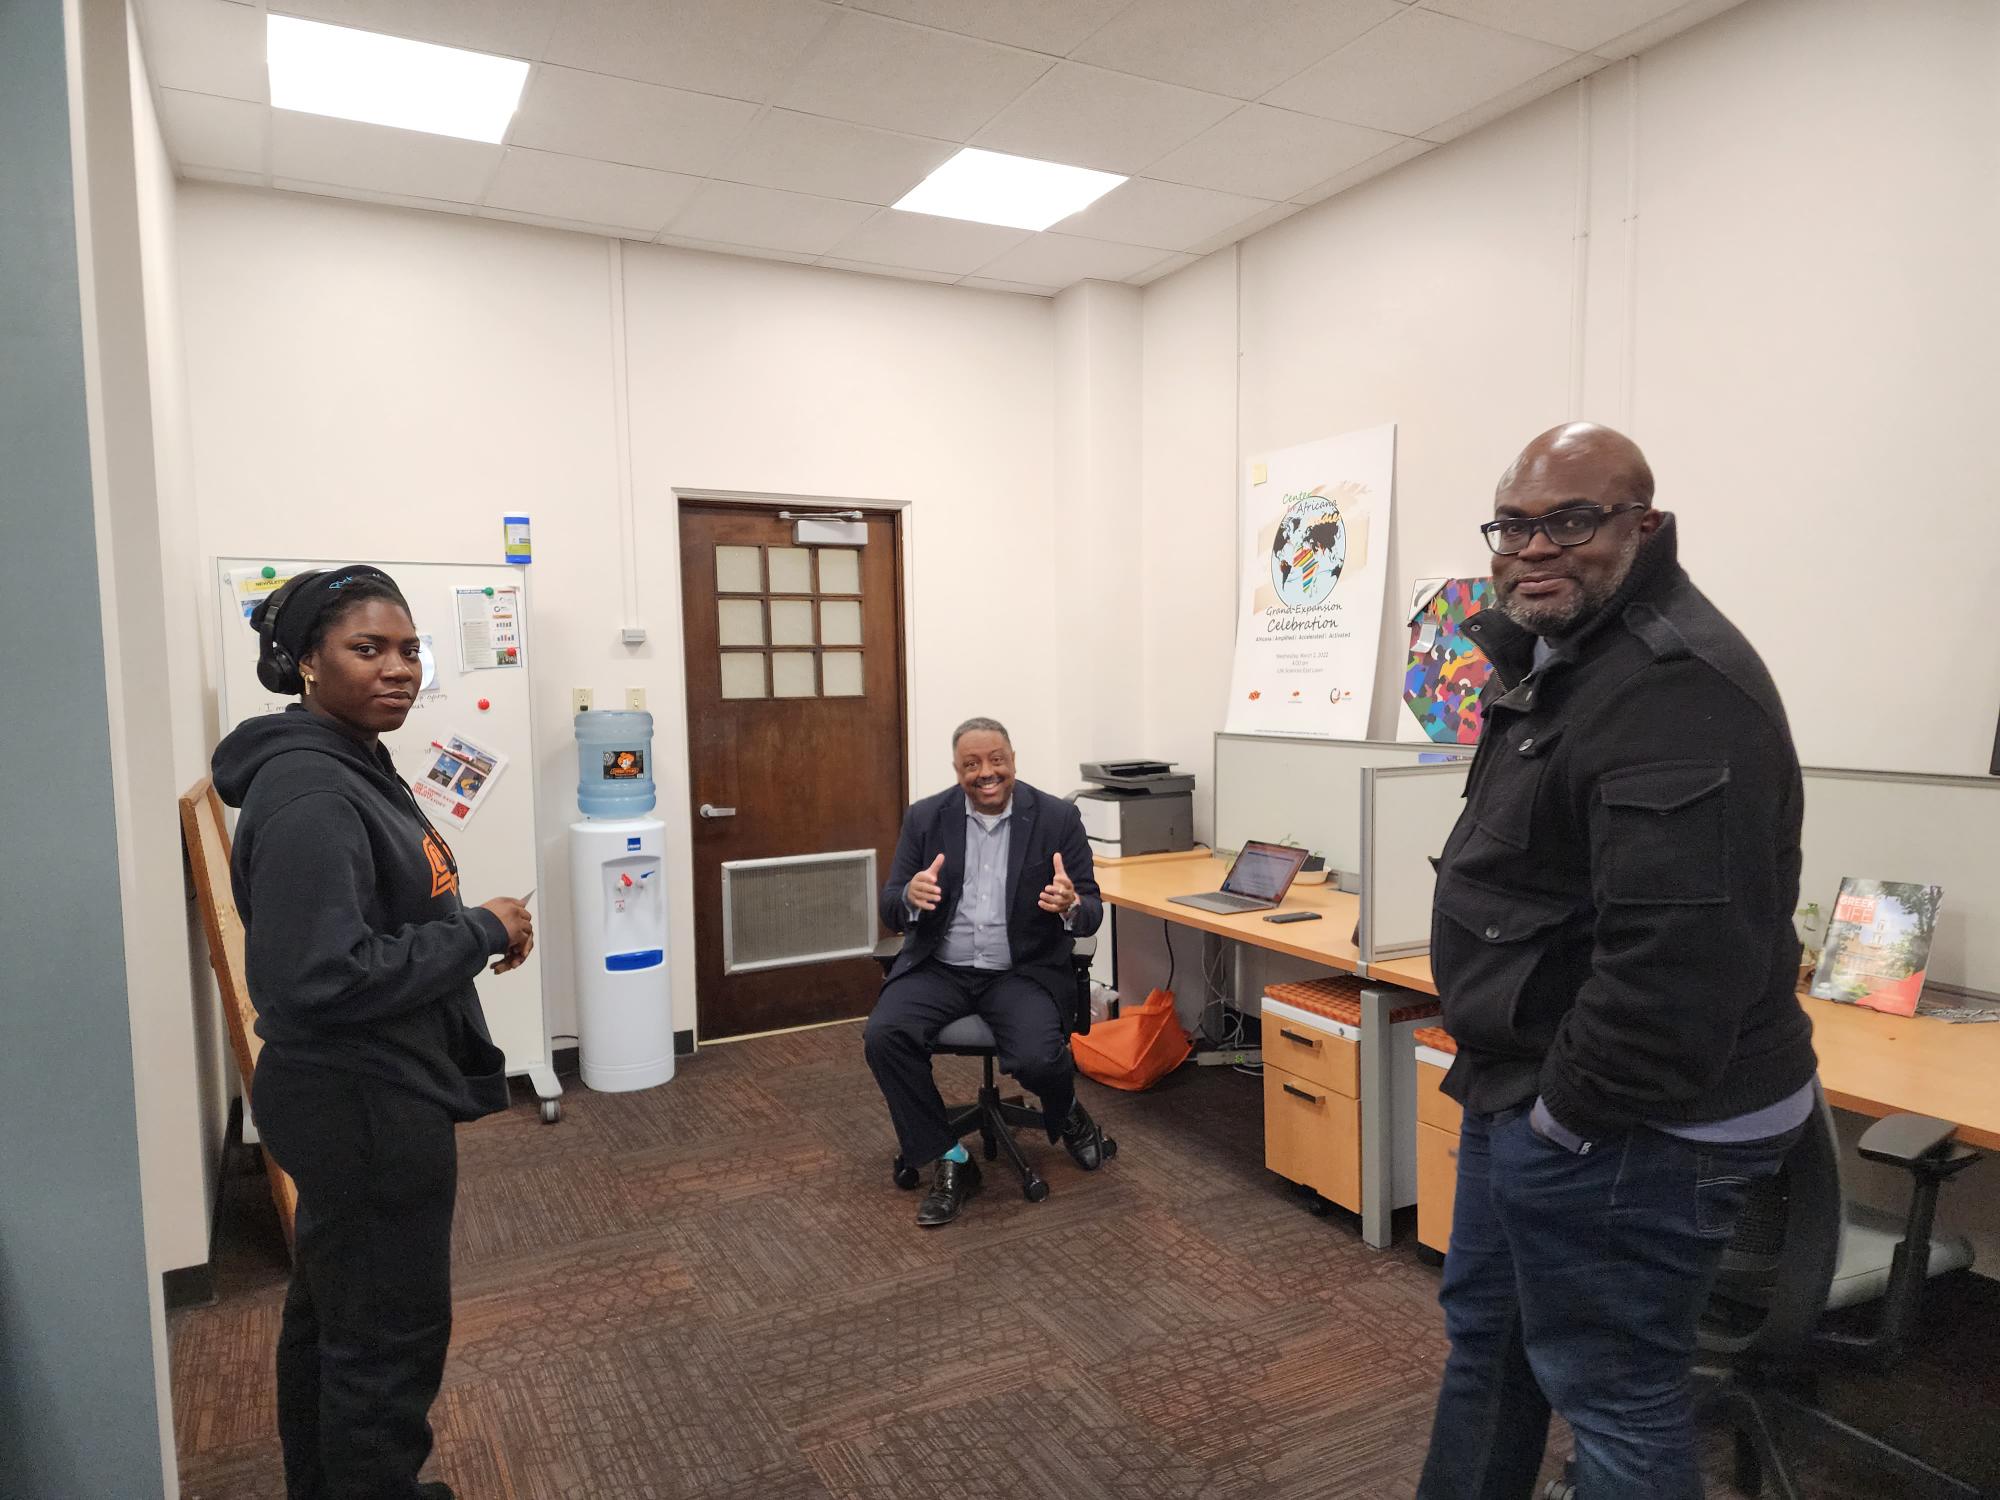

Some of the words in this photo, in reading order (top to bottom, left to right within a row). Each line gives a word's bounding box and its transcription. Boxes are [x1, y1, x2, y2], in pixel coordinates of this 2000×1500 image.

[1283, 491, 1312, 504] Center
[1297, 500, 1338, 515] Africana
[256, 579, 289, 587] NEWSLETTE
[1267, 615, 1338, 632] Celebration
[1839, 896, 1876, 909] GREEK
[1834, 905, 1873, 922] LIFE
